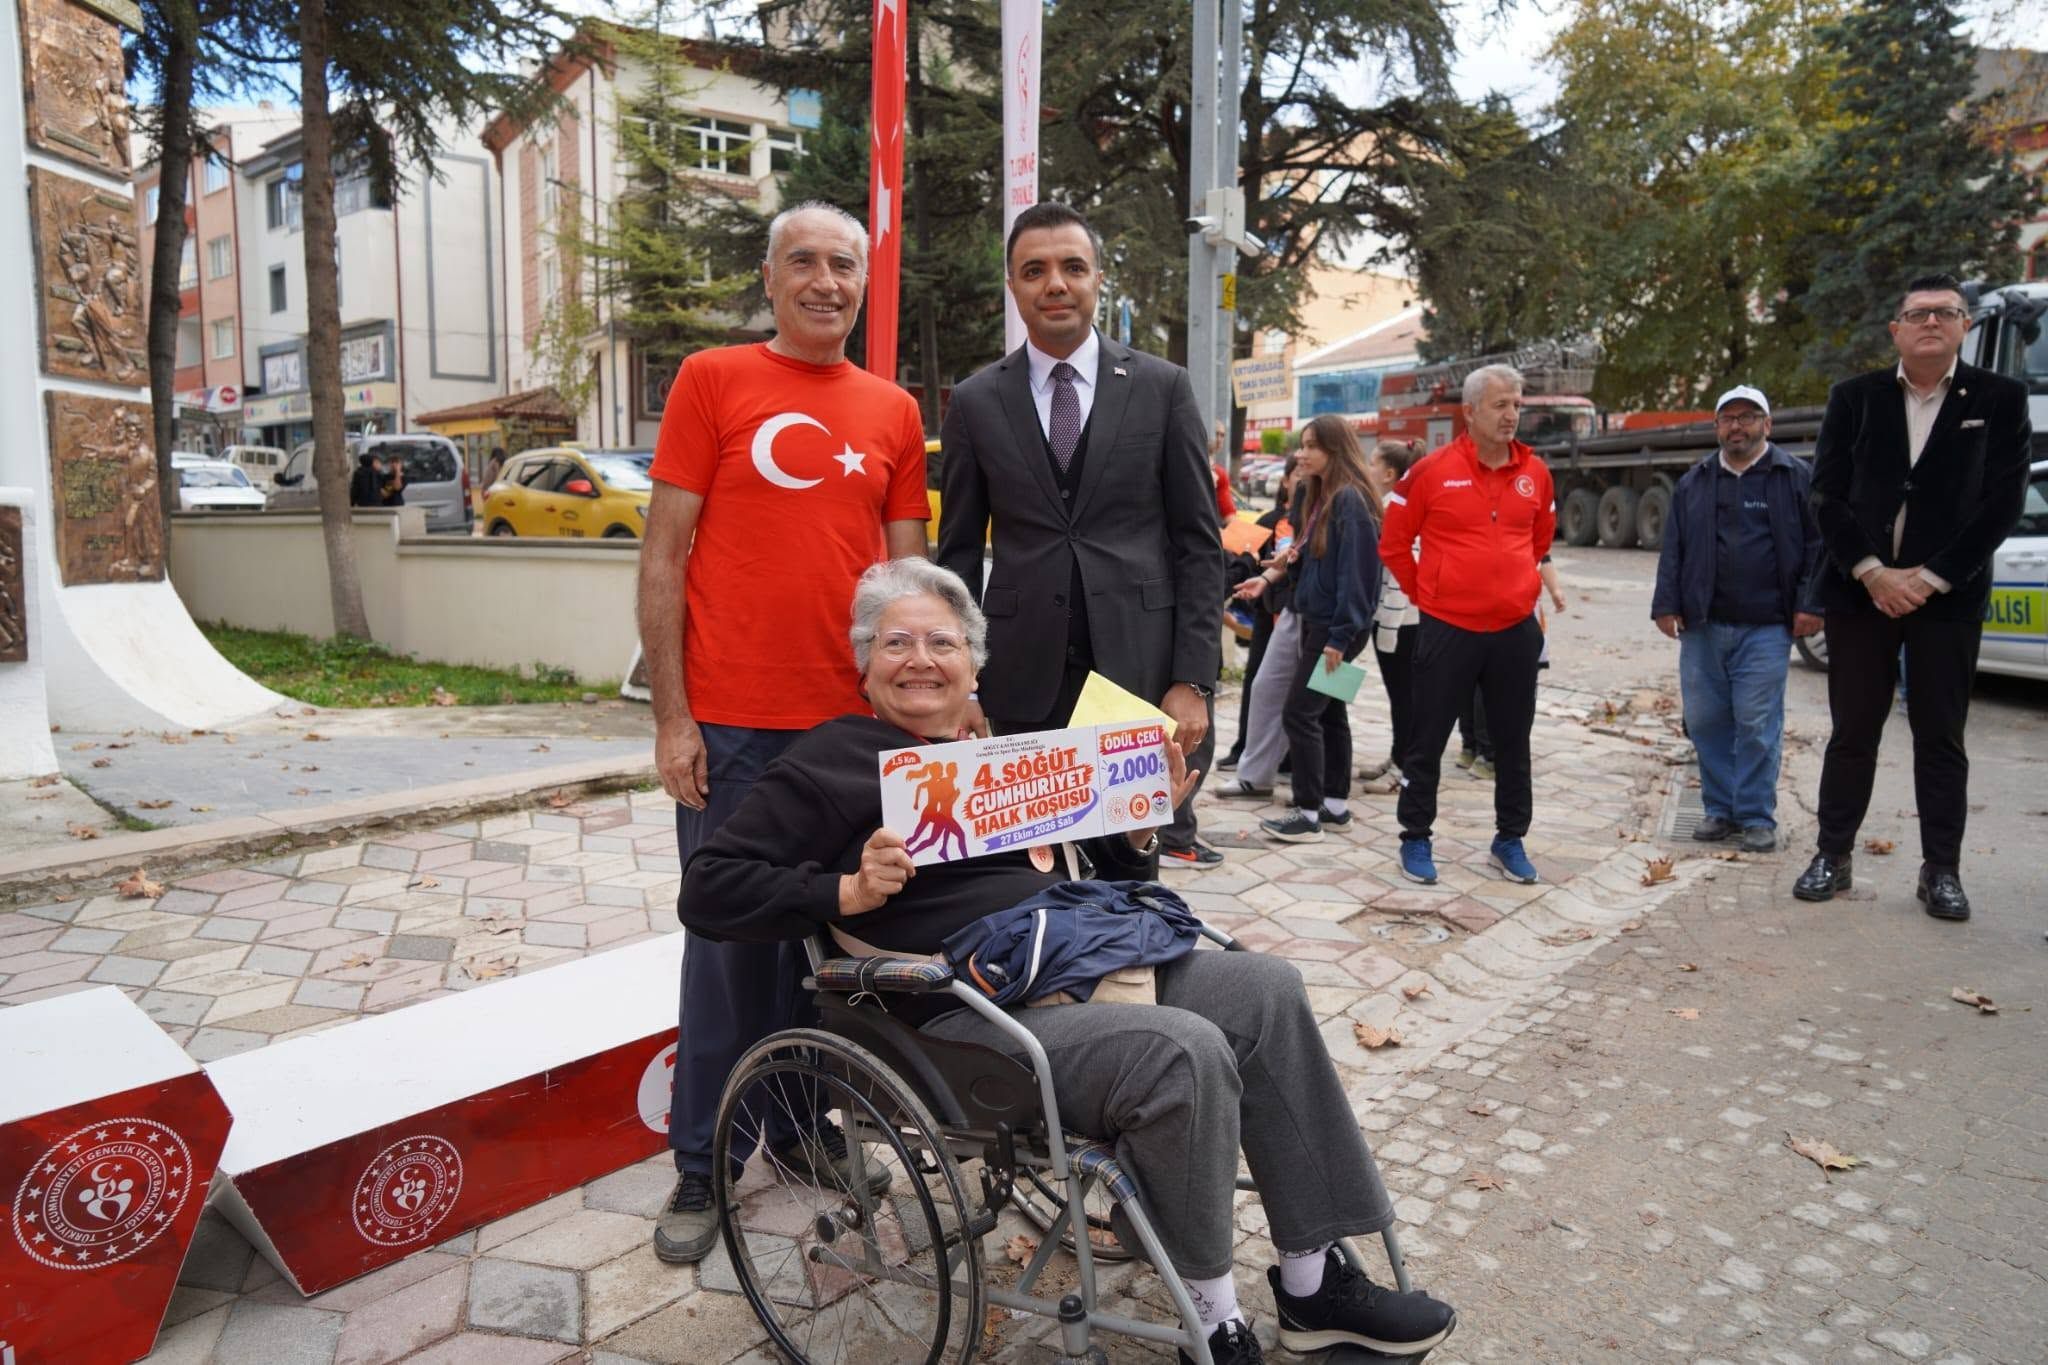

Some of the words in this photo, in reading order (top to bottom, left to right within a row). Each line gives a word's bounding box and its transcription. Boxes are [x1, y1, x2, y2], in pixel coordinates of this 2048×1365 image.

[1104, 732, 1135, 751] ÖDÜL
[1136, 726, 1159, 748] ÇEKİ
[971, 767, 1087, 816] CUMHURİYET
[974, 808, 1020, 838] HALK
[1026, 787, 1090, 818] KOŞUSU
[1000, 834, 1012, 846] 27
[1013, 828, 1033, 842] Ekim
[1034, 820, 1056, 836] 2026
[1057, 815, 1074, 828] Salı
[87, 1143, 134, 1161] GENÇLİK
[136, 1147, 149, 1159] VE
[145, 1156, 162, 1181] SPOR
[48, 1157, 85, 1222] CUMHURİYETİ
[54, 1223, 96, 1243] TÜRKİYE
